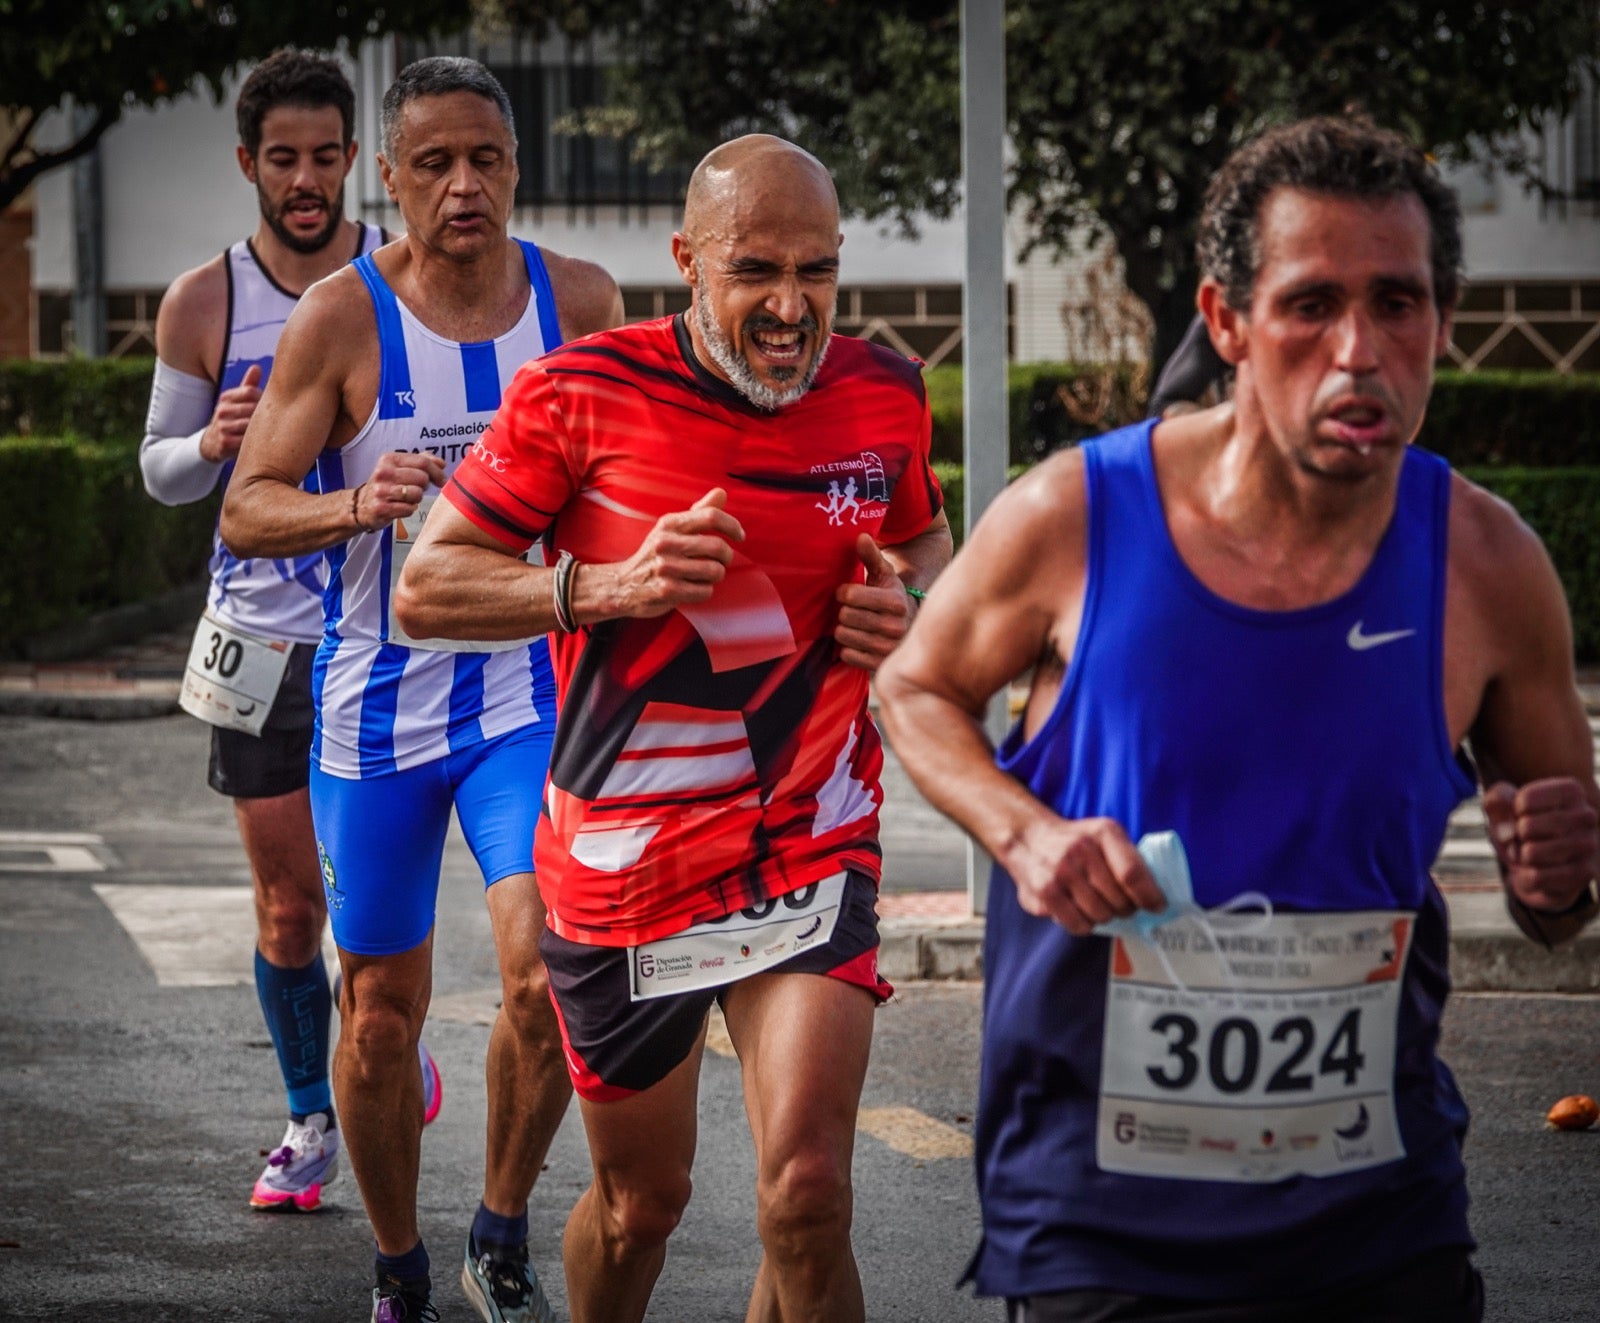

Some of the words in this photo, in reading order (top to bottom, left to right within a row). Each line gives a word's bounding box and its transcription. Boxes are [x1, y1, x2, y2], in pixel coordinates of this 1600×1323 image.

[810, 460, 863, 474] ATLETISMO
[204, 631, 244, 678] 30
[1145, 1007, 1365, 1095] 3024
